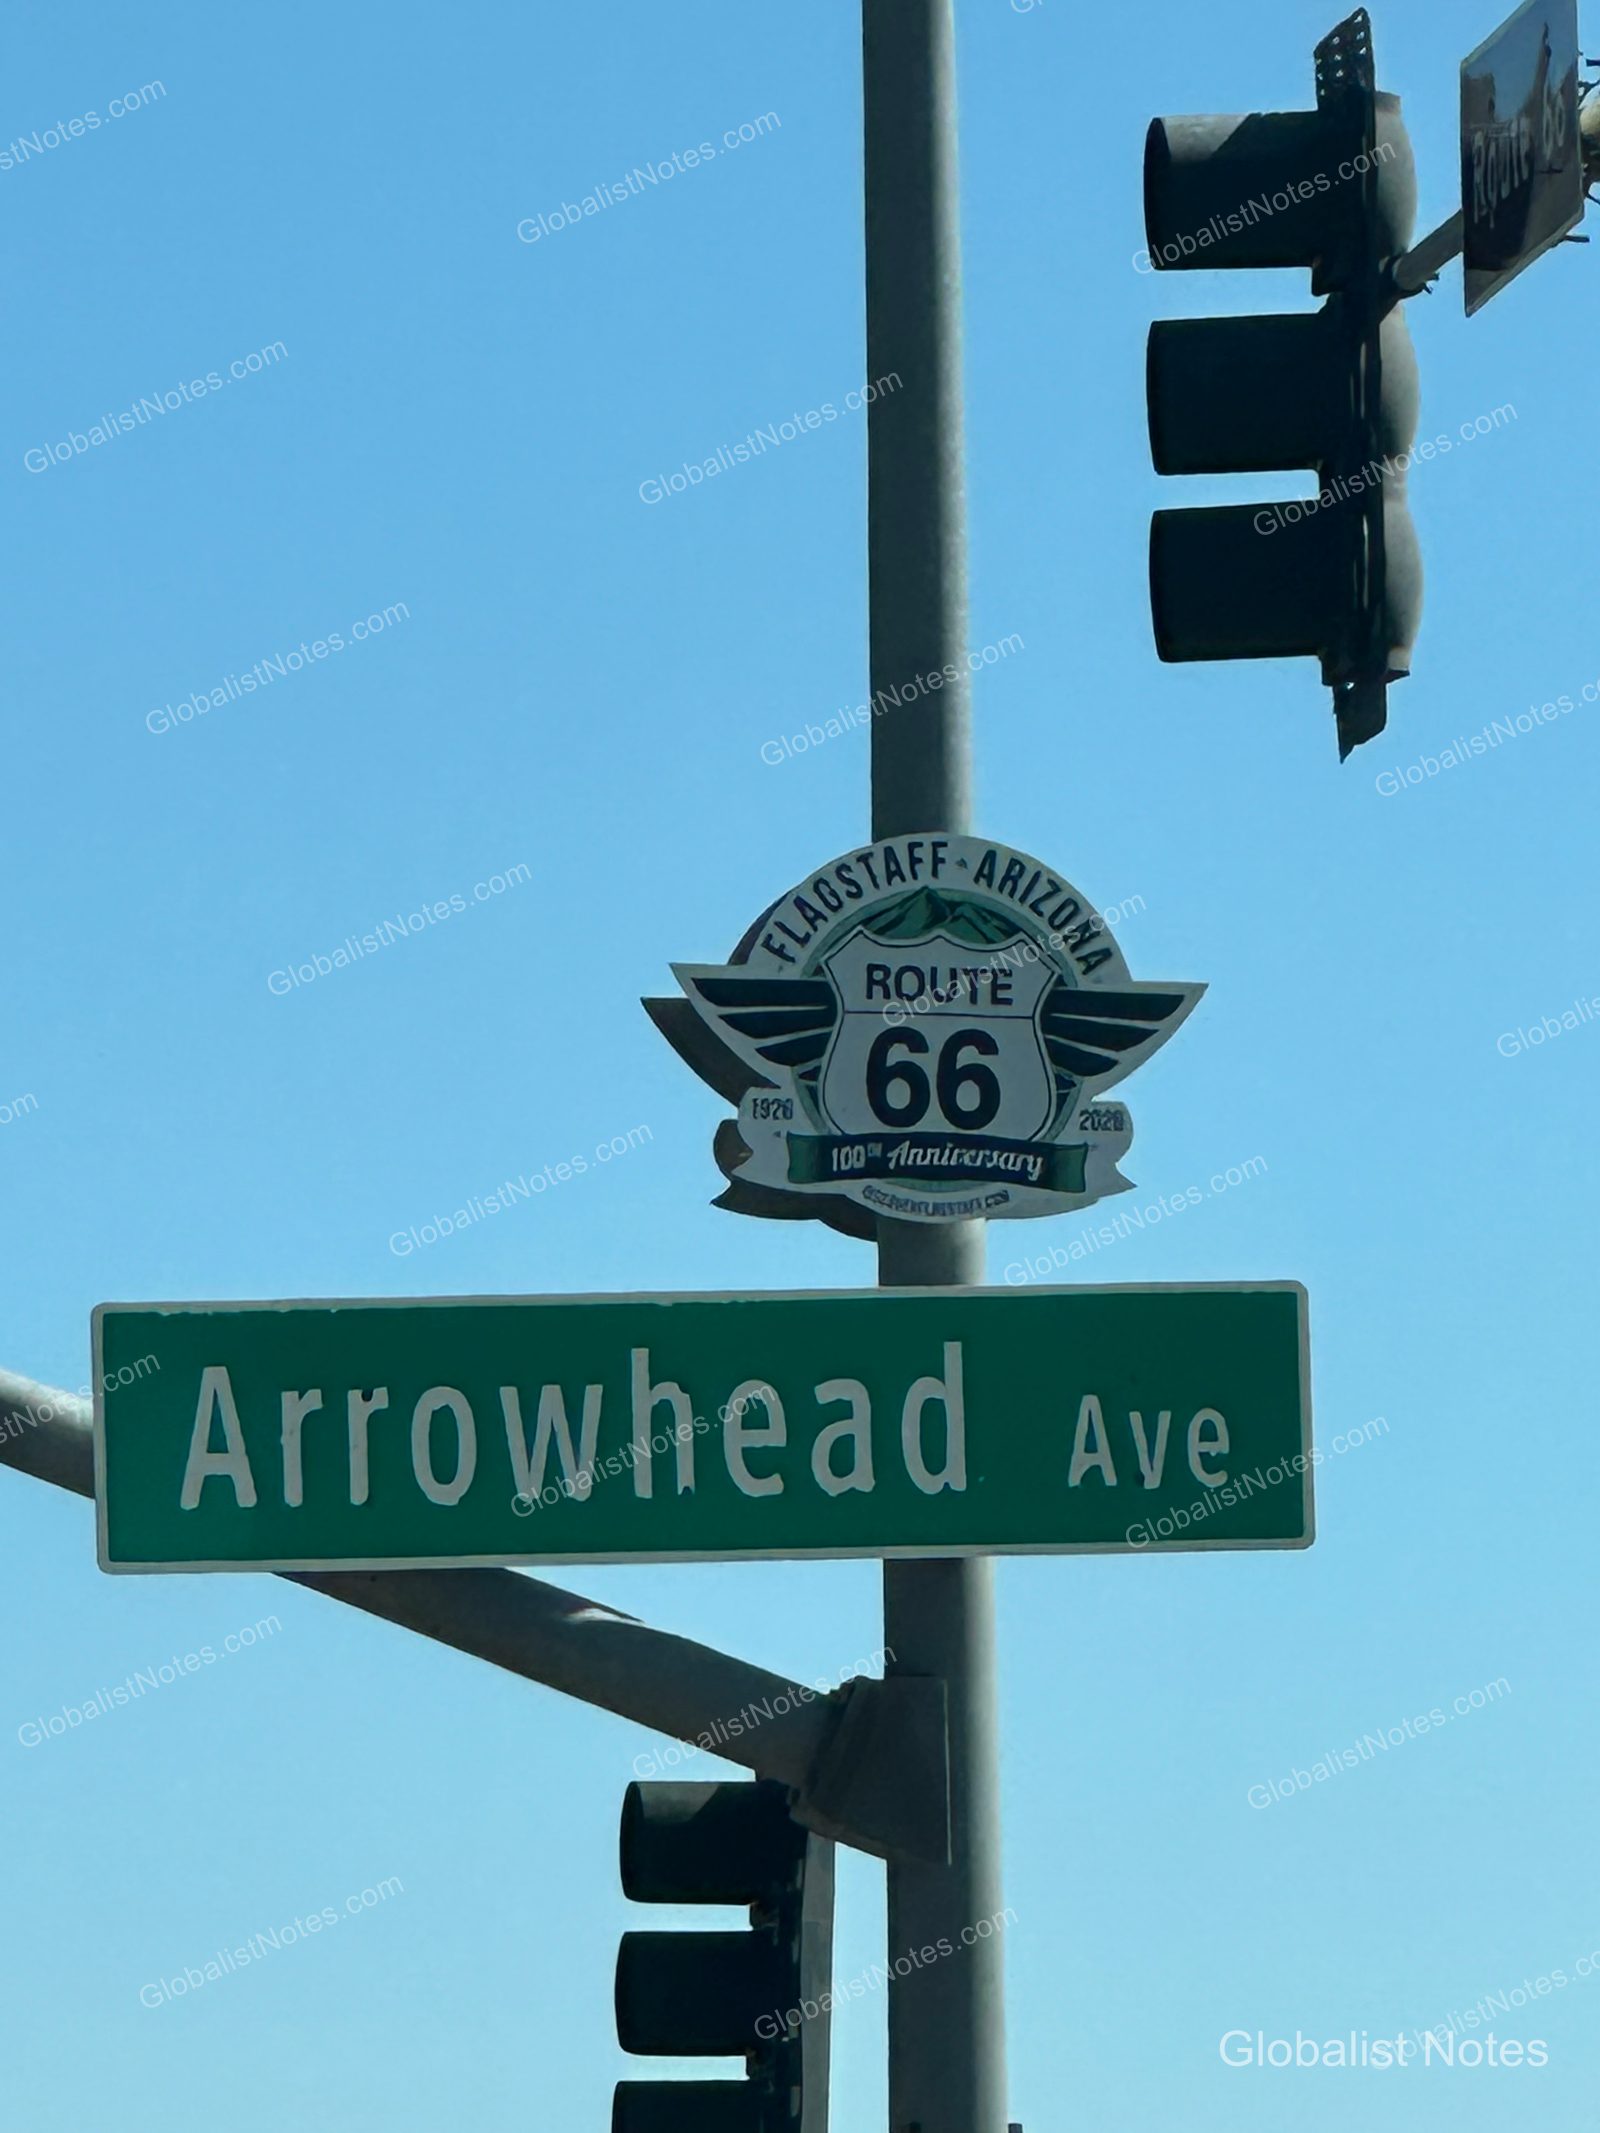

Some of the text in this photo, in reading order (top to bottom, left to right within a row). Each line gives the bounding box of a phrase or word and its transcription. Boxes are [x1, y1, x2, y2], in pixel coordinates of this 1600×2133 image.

[760, 841, 1113, 976] FLAGSTAFF ARIZONA
[866, 963, 1013, 1006] ROUTE
[866, 1026, 1001, 1131] 66
[887, 1140, 1044, 1181] Anniversary
[180, 1340, 1231, 1511] Arrowhead Ave
